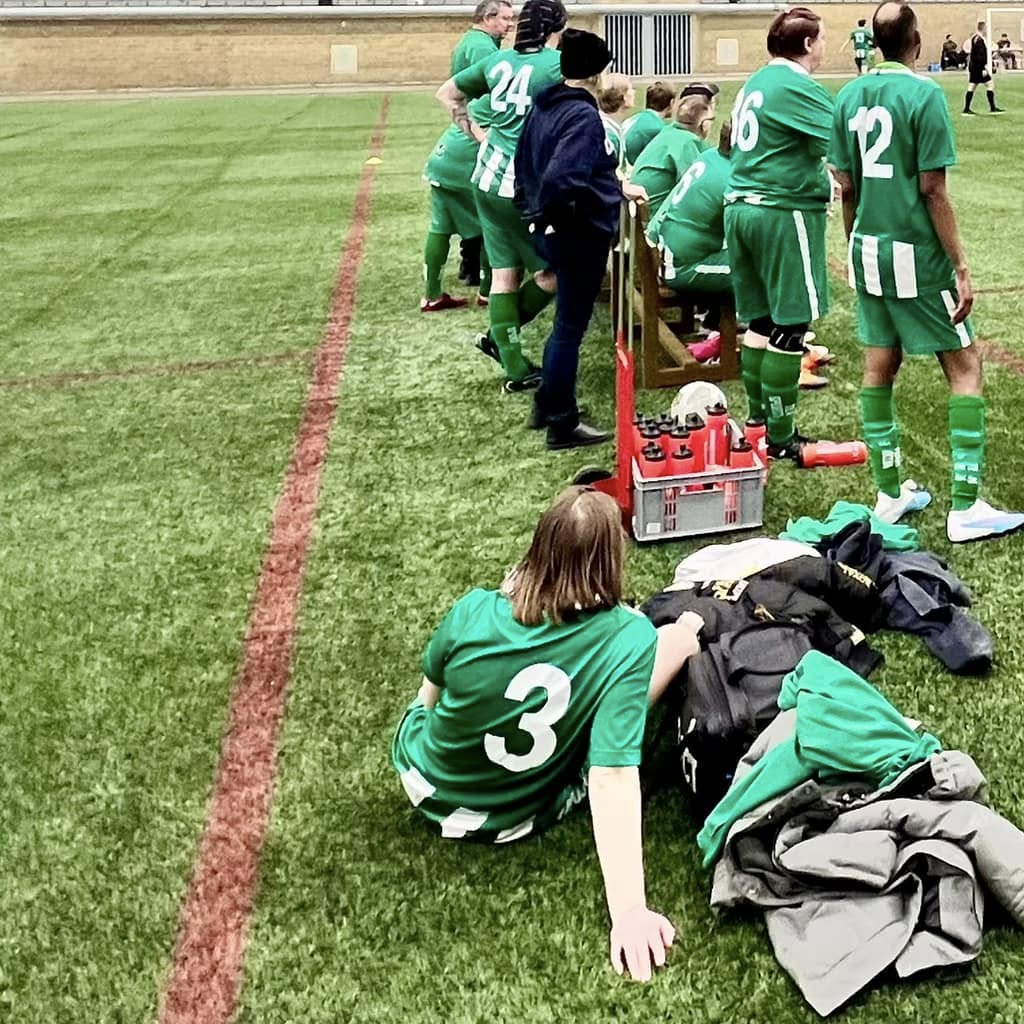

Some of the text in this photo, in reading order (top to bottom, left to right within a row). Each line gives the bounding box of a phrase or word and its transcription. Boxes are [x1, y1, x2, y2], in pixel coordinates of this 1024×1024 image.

[489, 60, 534, 116] 24
[848, 105, 894, 179] 12
[483, 662, 572, 772] 3
